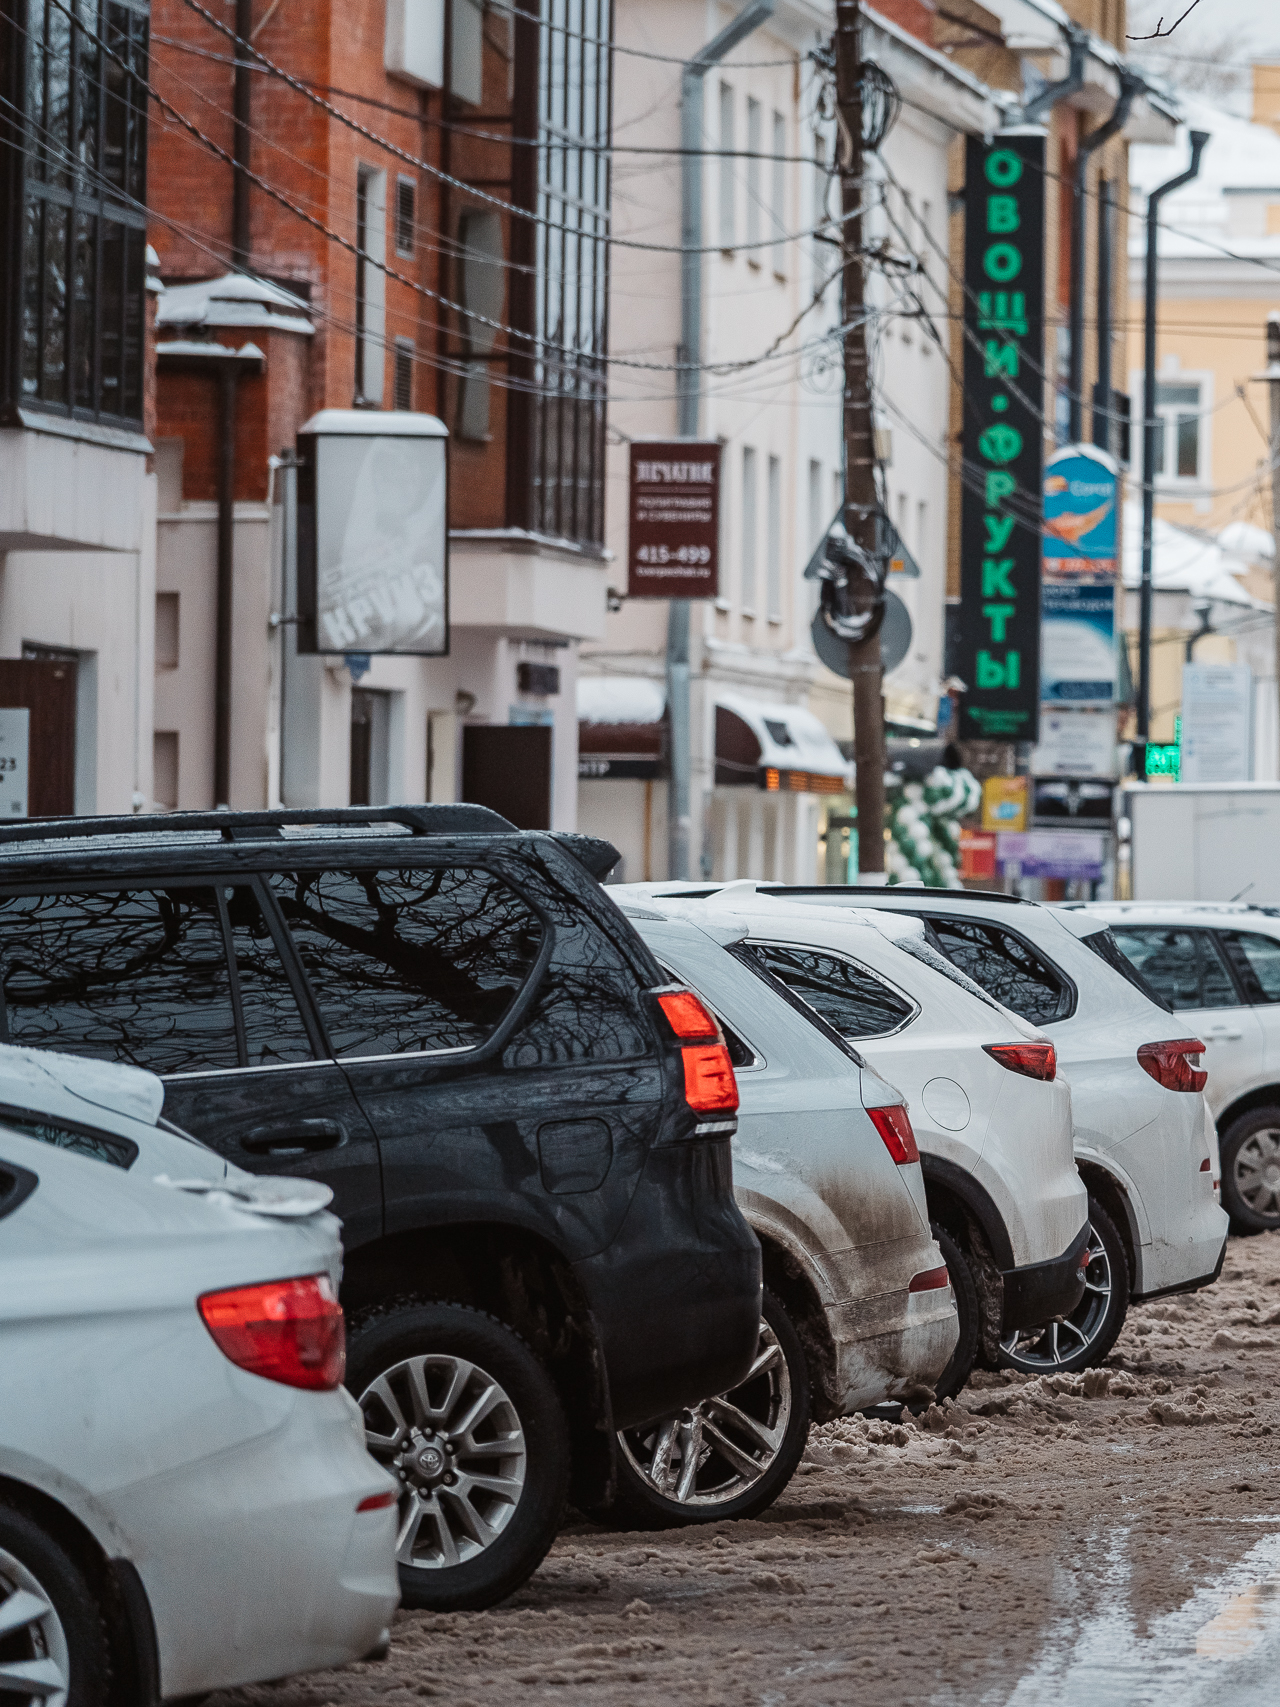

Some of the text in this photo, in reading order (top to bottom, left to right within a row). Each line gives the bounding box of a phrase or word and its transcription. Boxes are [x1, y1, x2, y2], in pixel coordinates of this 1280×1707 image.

[976, 148, 1029, 378] ОВОЩИ
[636, 545, 712, 565] 415-499
[976, 423, 1024, 690] ФРУКТЫ
